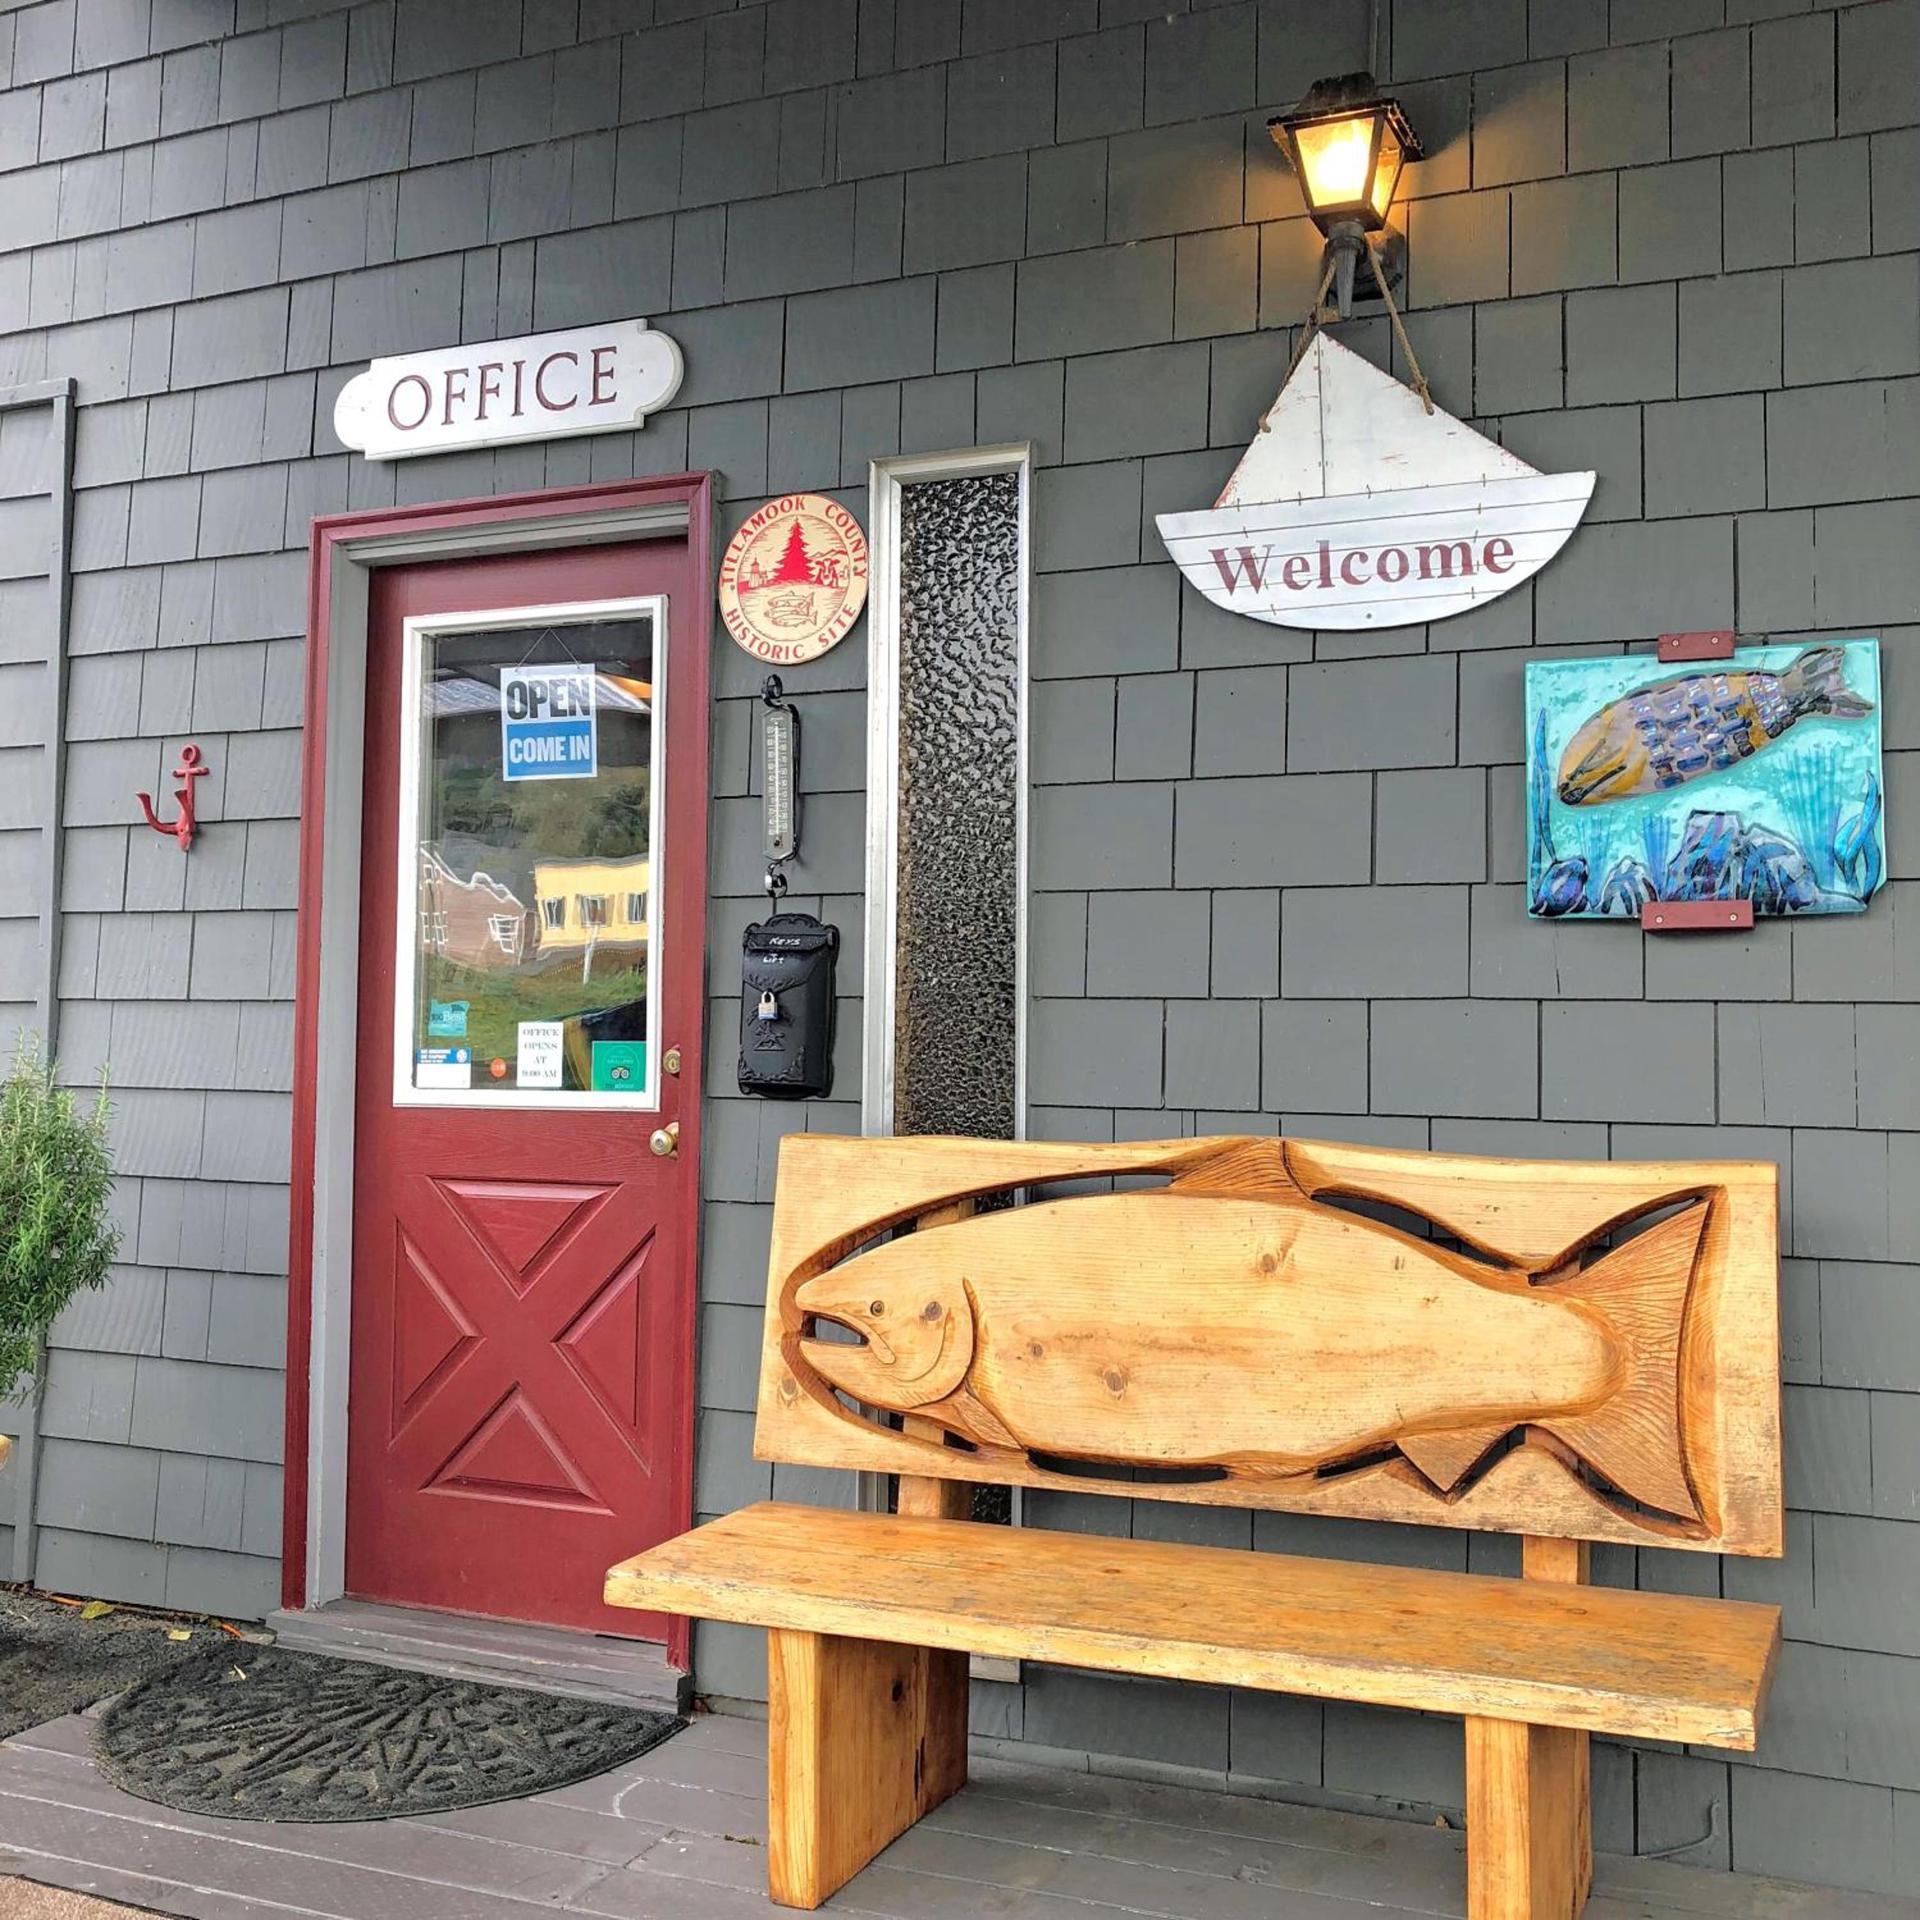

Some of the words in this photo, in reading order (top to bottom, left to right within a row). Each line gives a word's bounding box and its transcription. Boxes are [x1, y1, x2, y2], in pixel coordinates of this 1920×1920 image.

[388, 346, 618, 431] OFFICE
[722, 496, 806, 584] TILLAMOOK
[825, 504, 868, 579] COUNTY
[1208, 536, 1517, 597] Welcome
[726, 608, 805, 660] HISTORIC
[818, 604, 857, 648] SITE
[507, 678, 591, 720] OPEN
[509, 735, 567, 764] COME
[569, 735, 590, 761] IN
[522, 1028, 560, 1037] OFFICE
[523, 1041, 559, 1050] OPENS
